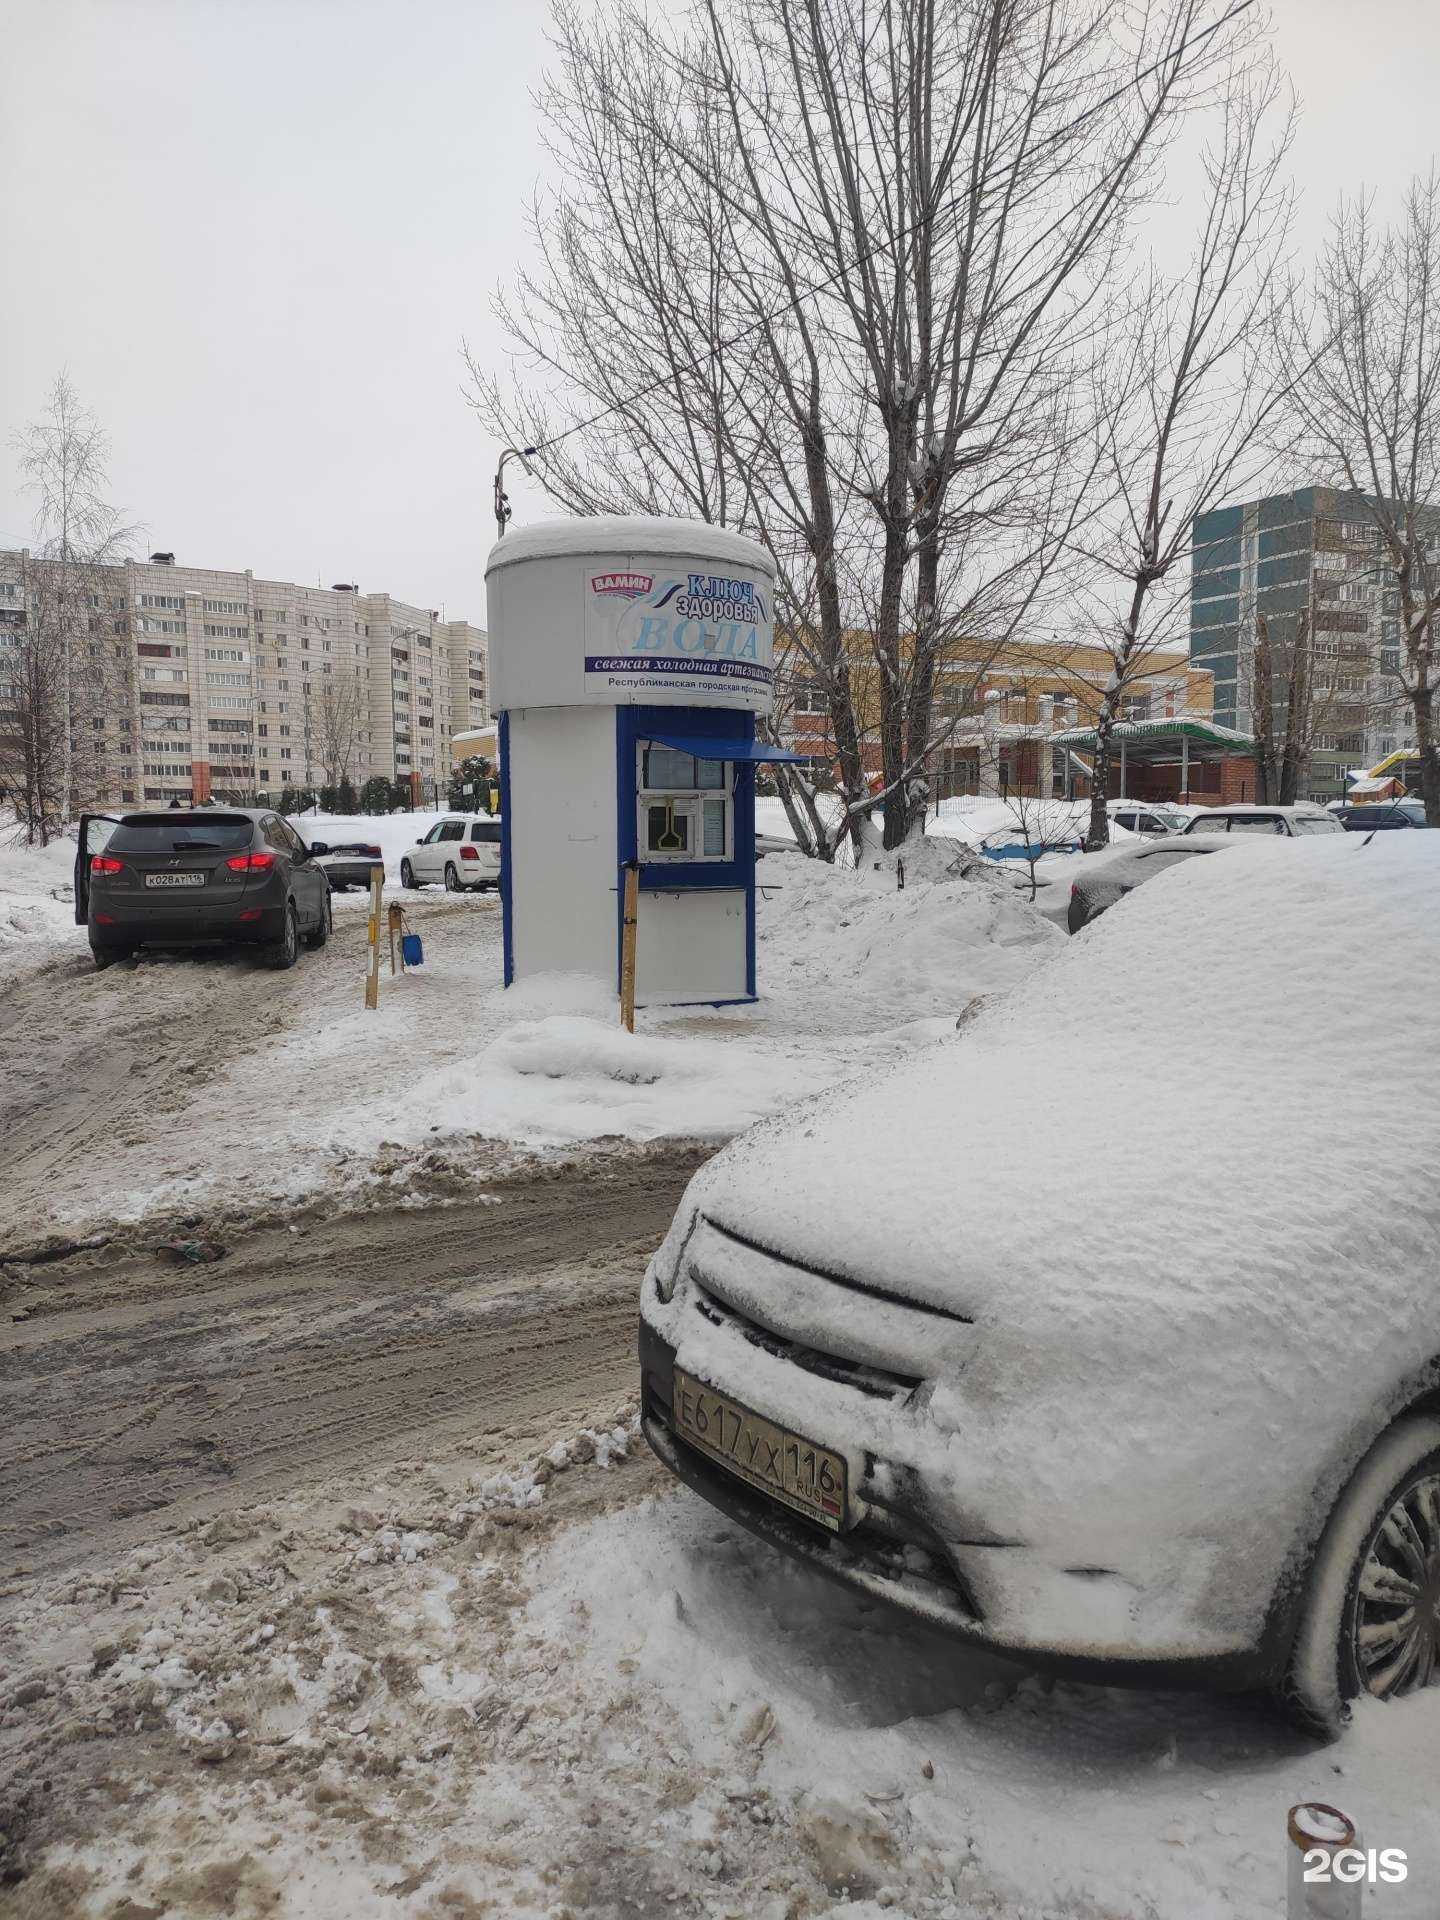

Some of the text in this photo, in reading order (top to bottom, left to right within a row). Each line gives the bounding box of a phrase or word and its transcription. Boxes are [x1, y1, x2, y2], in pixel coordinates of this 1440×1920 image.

[594, 575, 650, 591] ВАМИН
[687, 574, 755, 604] КЛЮЧ
[631, 617, 758, 659] ВОДА
[594, 659, 651, 670] свежая
[653, 659, 718, 673] холодная
[608, 677, 696, 689] Республиканская
[698, 681, 740, 692] городская
[796, 1480, 822, 1503] RUS
